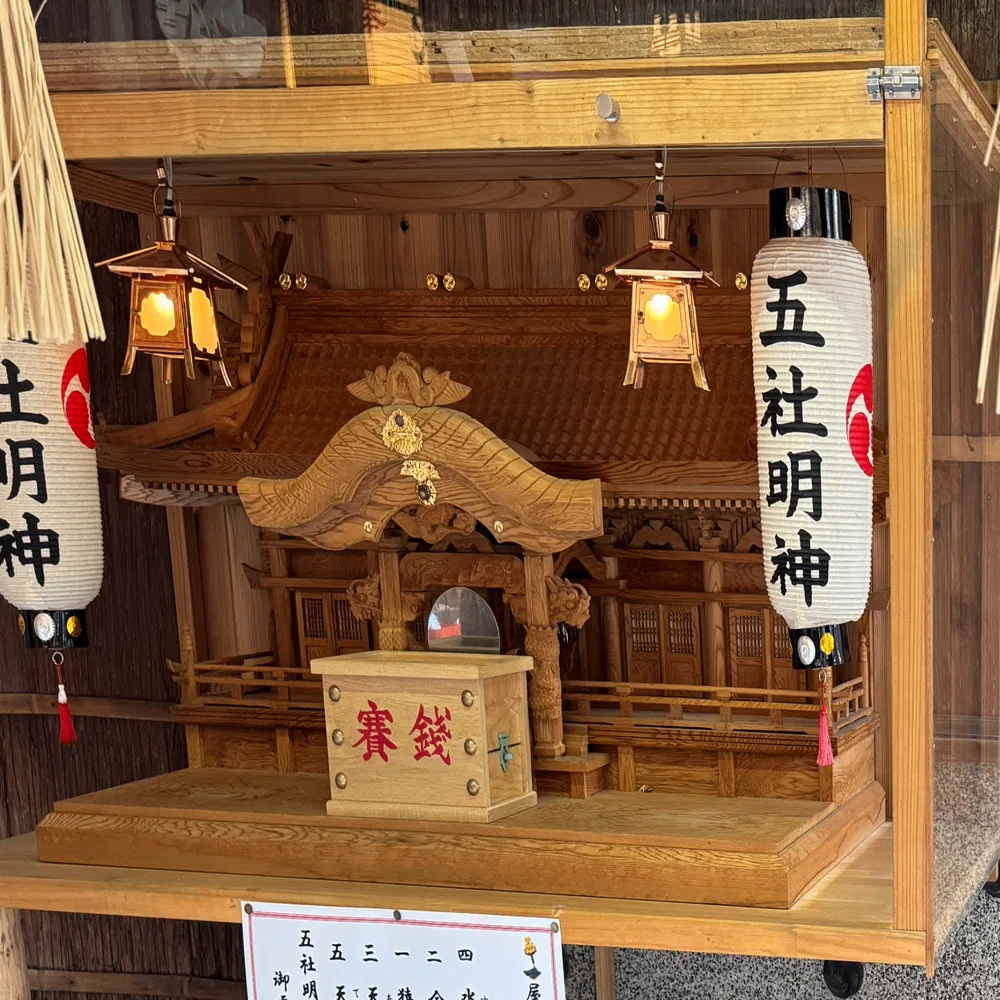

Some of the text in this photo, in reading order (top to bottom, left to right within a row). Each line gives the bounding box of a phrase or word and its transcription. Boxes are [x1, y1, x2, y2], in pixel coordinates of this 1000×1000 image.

[759, 268, 832, 608] 五社明神
[0, 340, 61, 586] 社明神
[330, 944, 345, 961] 五
[363, 945, 378, 962] 三
[427, 951, 442, 962] 二
[458, 950, 473, 961] 四
